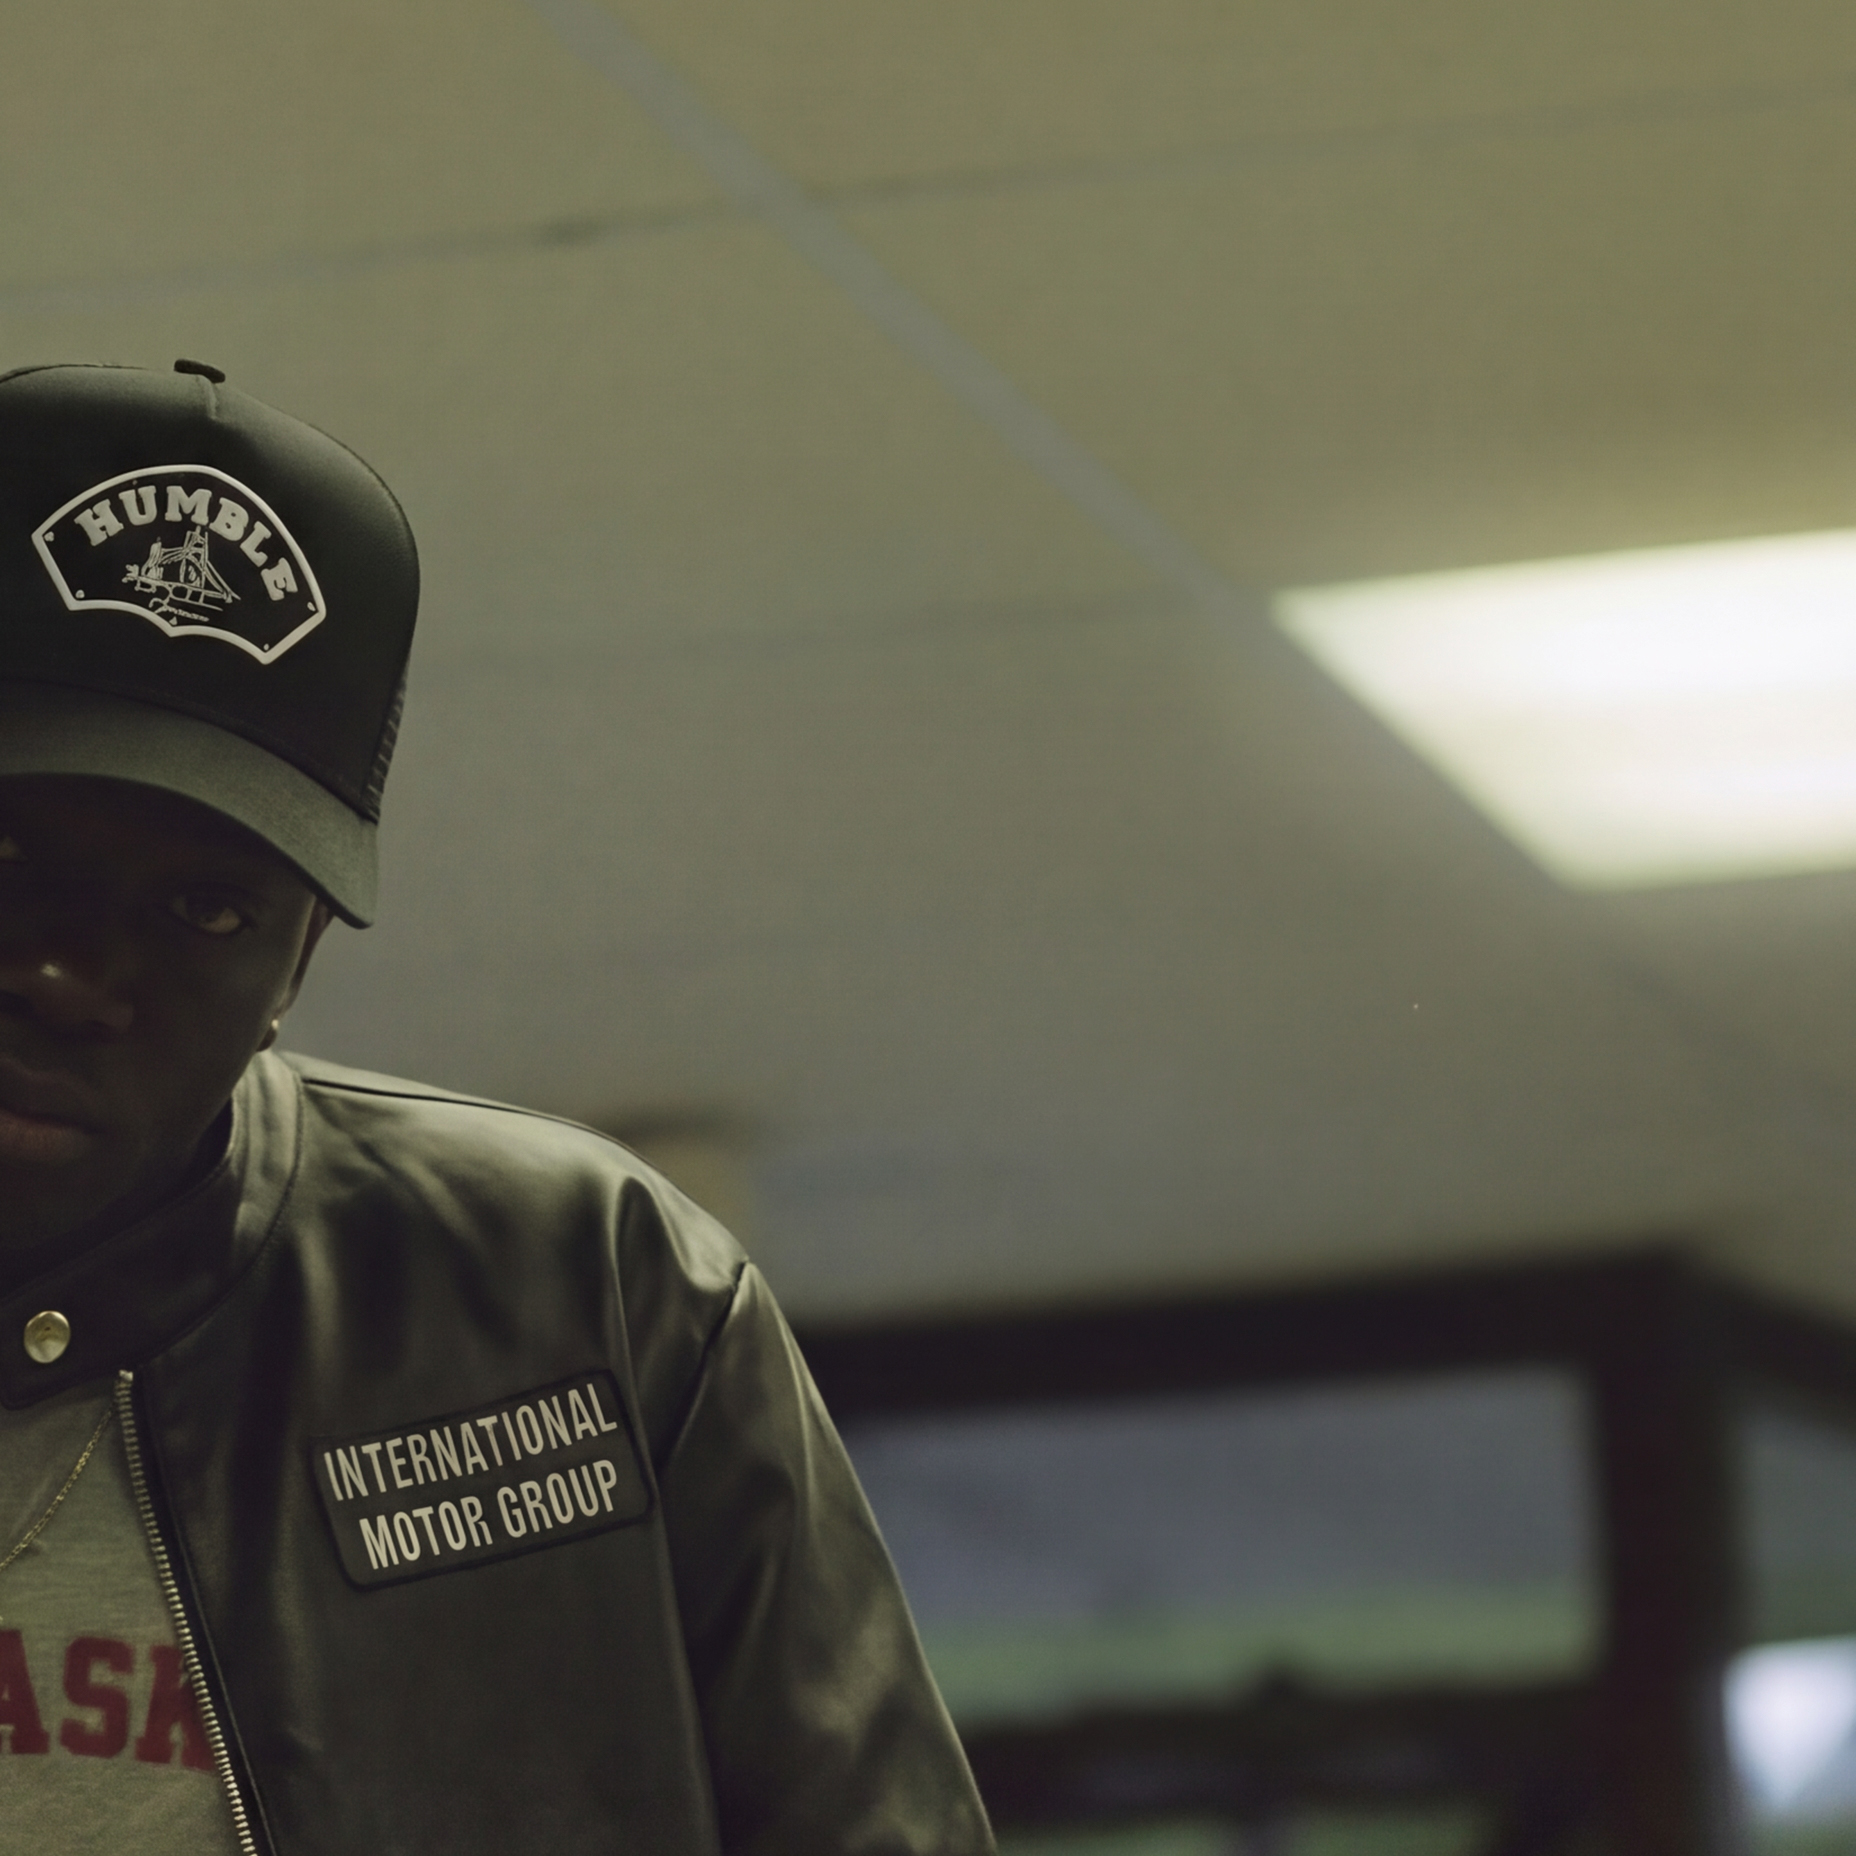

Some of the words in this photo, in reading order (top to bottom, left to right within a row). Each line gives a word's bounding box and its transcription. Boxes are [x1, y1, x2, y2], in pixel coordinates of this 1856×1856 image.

[74, 485, 298, 601] HUMBLE
[324, 1383, 617, 1501] INTERNATIONAL
[359, 1495, 493, 1570] MOTOR
[496, 1459, 618, 1538] GROUP
